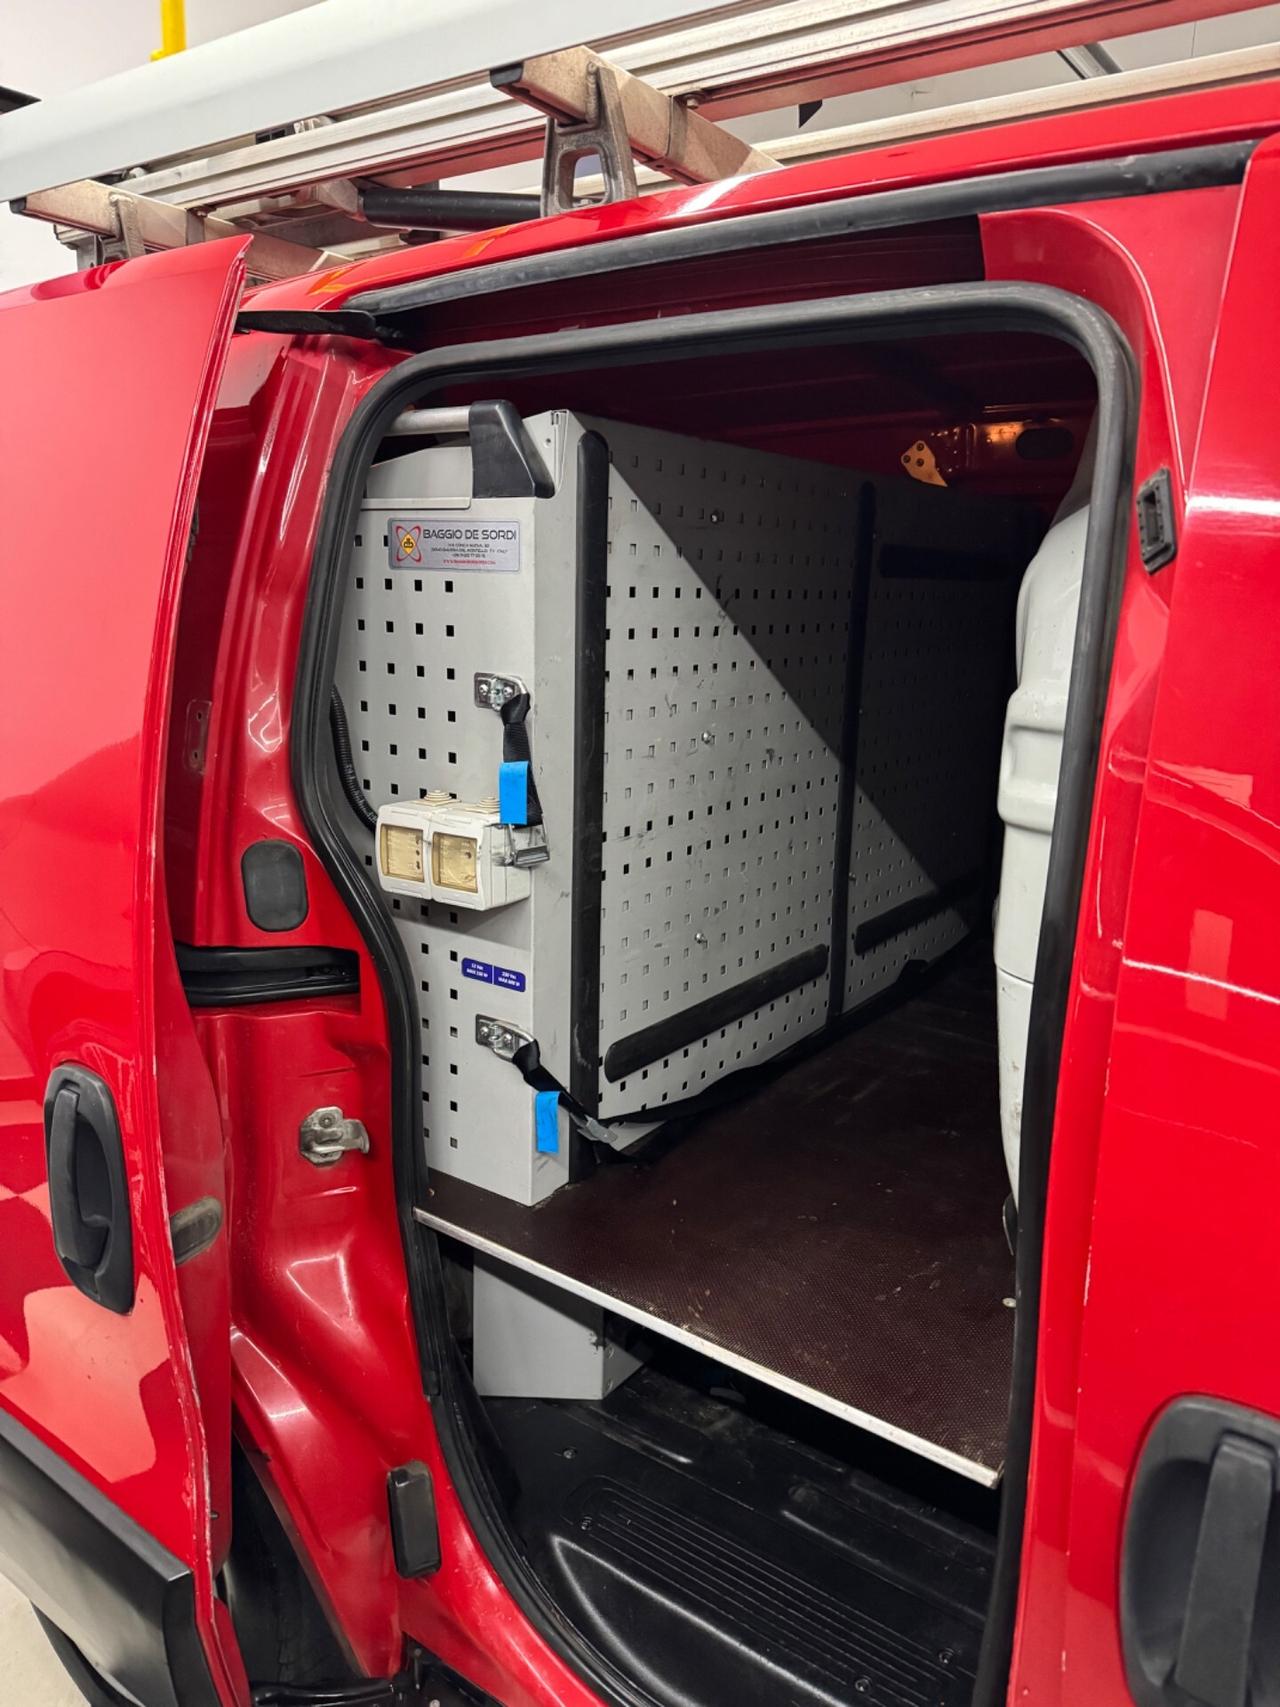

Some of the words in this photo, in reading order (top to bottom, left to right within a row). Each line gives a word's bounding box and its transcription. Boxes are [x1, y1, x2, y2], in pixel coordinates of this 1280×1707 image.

[423, 529, 462, 539] BAGGIO
[465, 530, 479, 540] DE
[481, 530, 516, 540] SORDI
